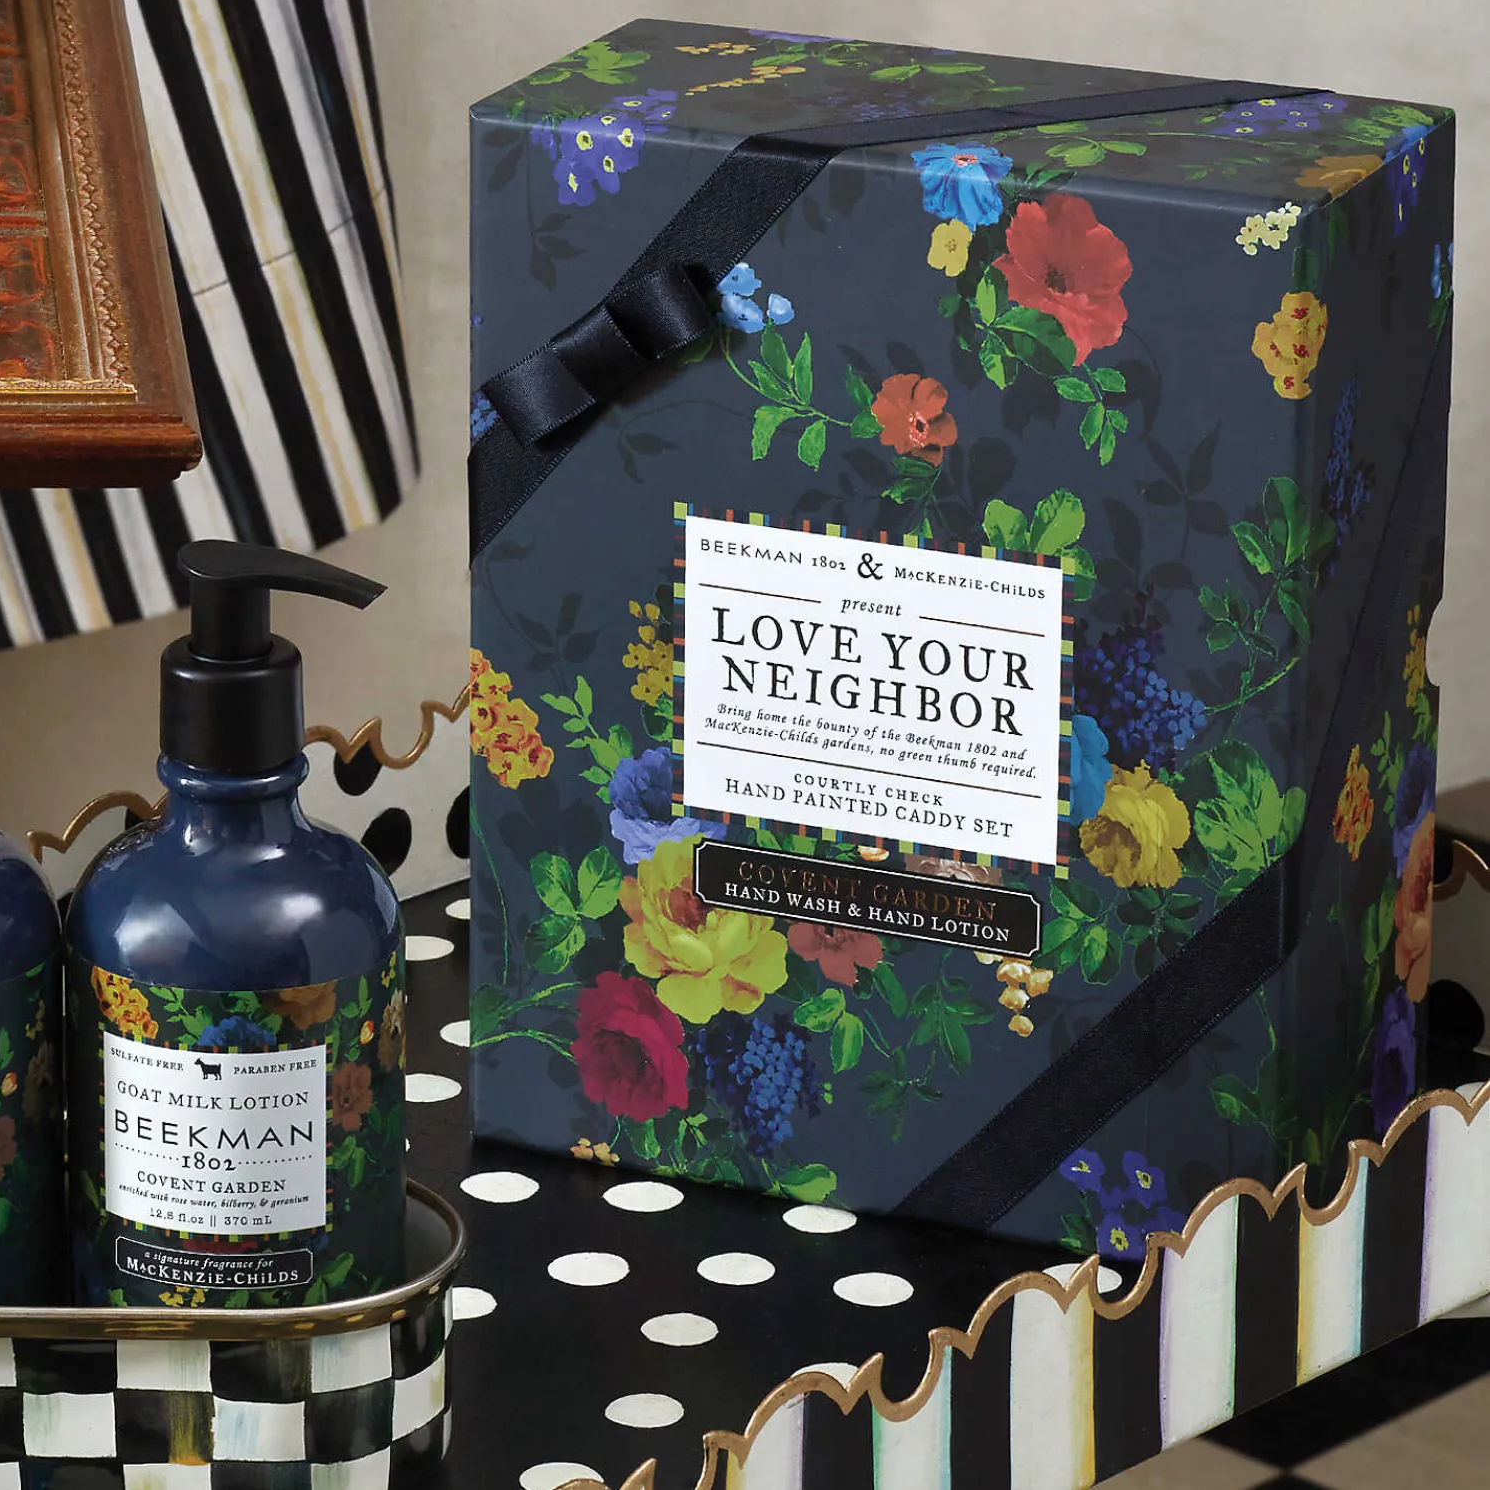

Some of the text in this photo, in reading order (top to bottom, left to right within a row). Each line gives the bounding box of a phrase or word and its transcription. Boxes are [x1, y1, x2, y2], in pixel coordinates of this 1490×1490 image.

[700, 539, 802, 564] BEEKMAN
[811, 557, 846, 571] 1802
[857, 553, 883, 580] &
[841, 598, 902, 617] present
[712, 607, 1034, 690] LOVE YOUR
[722, 656, 1023, 736] NEIGHBOR
[704, 718, 1036, 779] MacKenzie-Childs gardens, no green thumb required.
[716, 704, 1026, 761] Bring home the bounty of the Beekman 1802 and
[794, 773, 943, 806] COURTLY CHECK
[726, 779, 1012, 838] HAND PAINTED CADDY SET
[738, 860, 996, 920] COVENT GARDEN
[726, 883, 1010, 942] HAND WASH & HAND LOTION
[111, 1048, 183, 1071] SULFATE FREE
[234, 1060, 317, 1075] PARABEN FREE
[117, 1080, 309, 1110] GOAT MILK LOTION
[115, 1109, 313, 1149] BEEKMAN
[182, 1151, 235, 1171] 1802
[137, 1171, 286, 1194] COVENT GARDEN
[149, 1208, 272, 1226] 12.5 fl.oz 370 mL
[150, 1192, 168, 1202] with
[190, 1199, 217, 1209] water,
[221, 1198, 256, 1210] bilberry,
[259, 1198, 268, 1207] &
[271, 1194, 309, 1209] geranium
[152, 1252, 199, 1268] signature
[201, 1258, 254, 1270] fragrance
[256, 1258, 274, 1270] for
